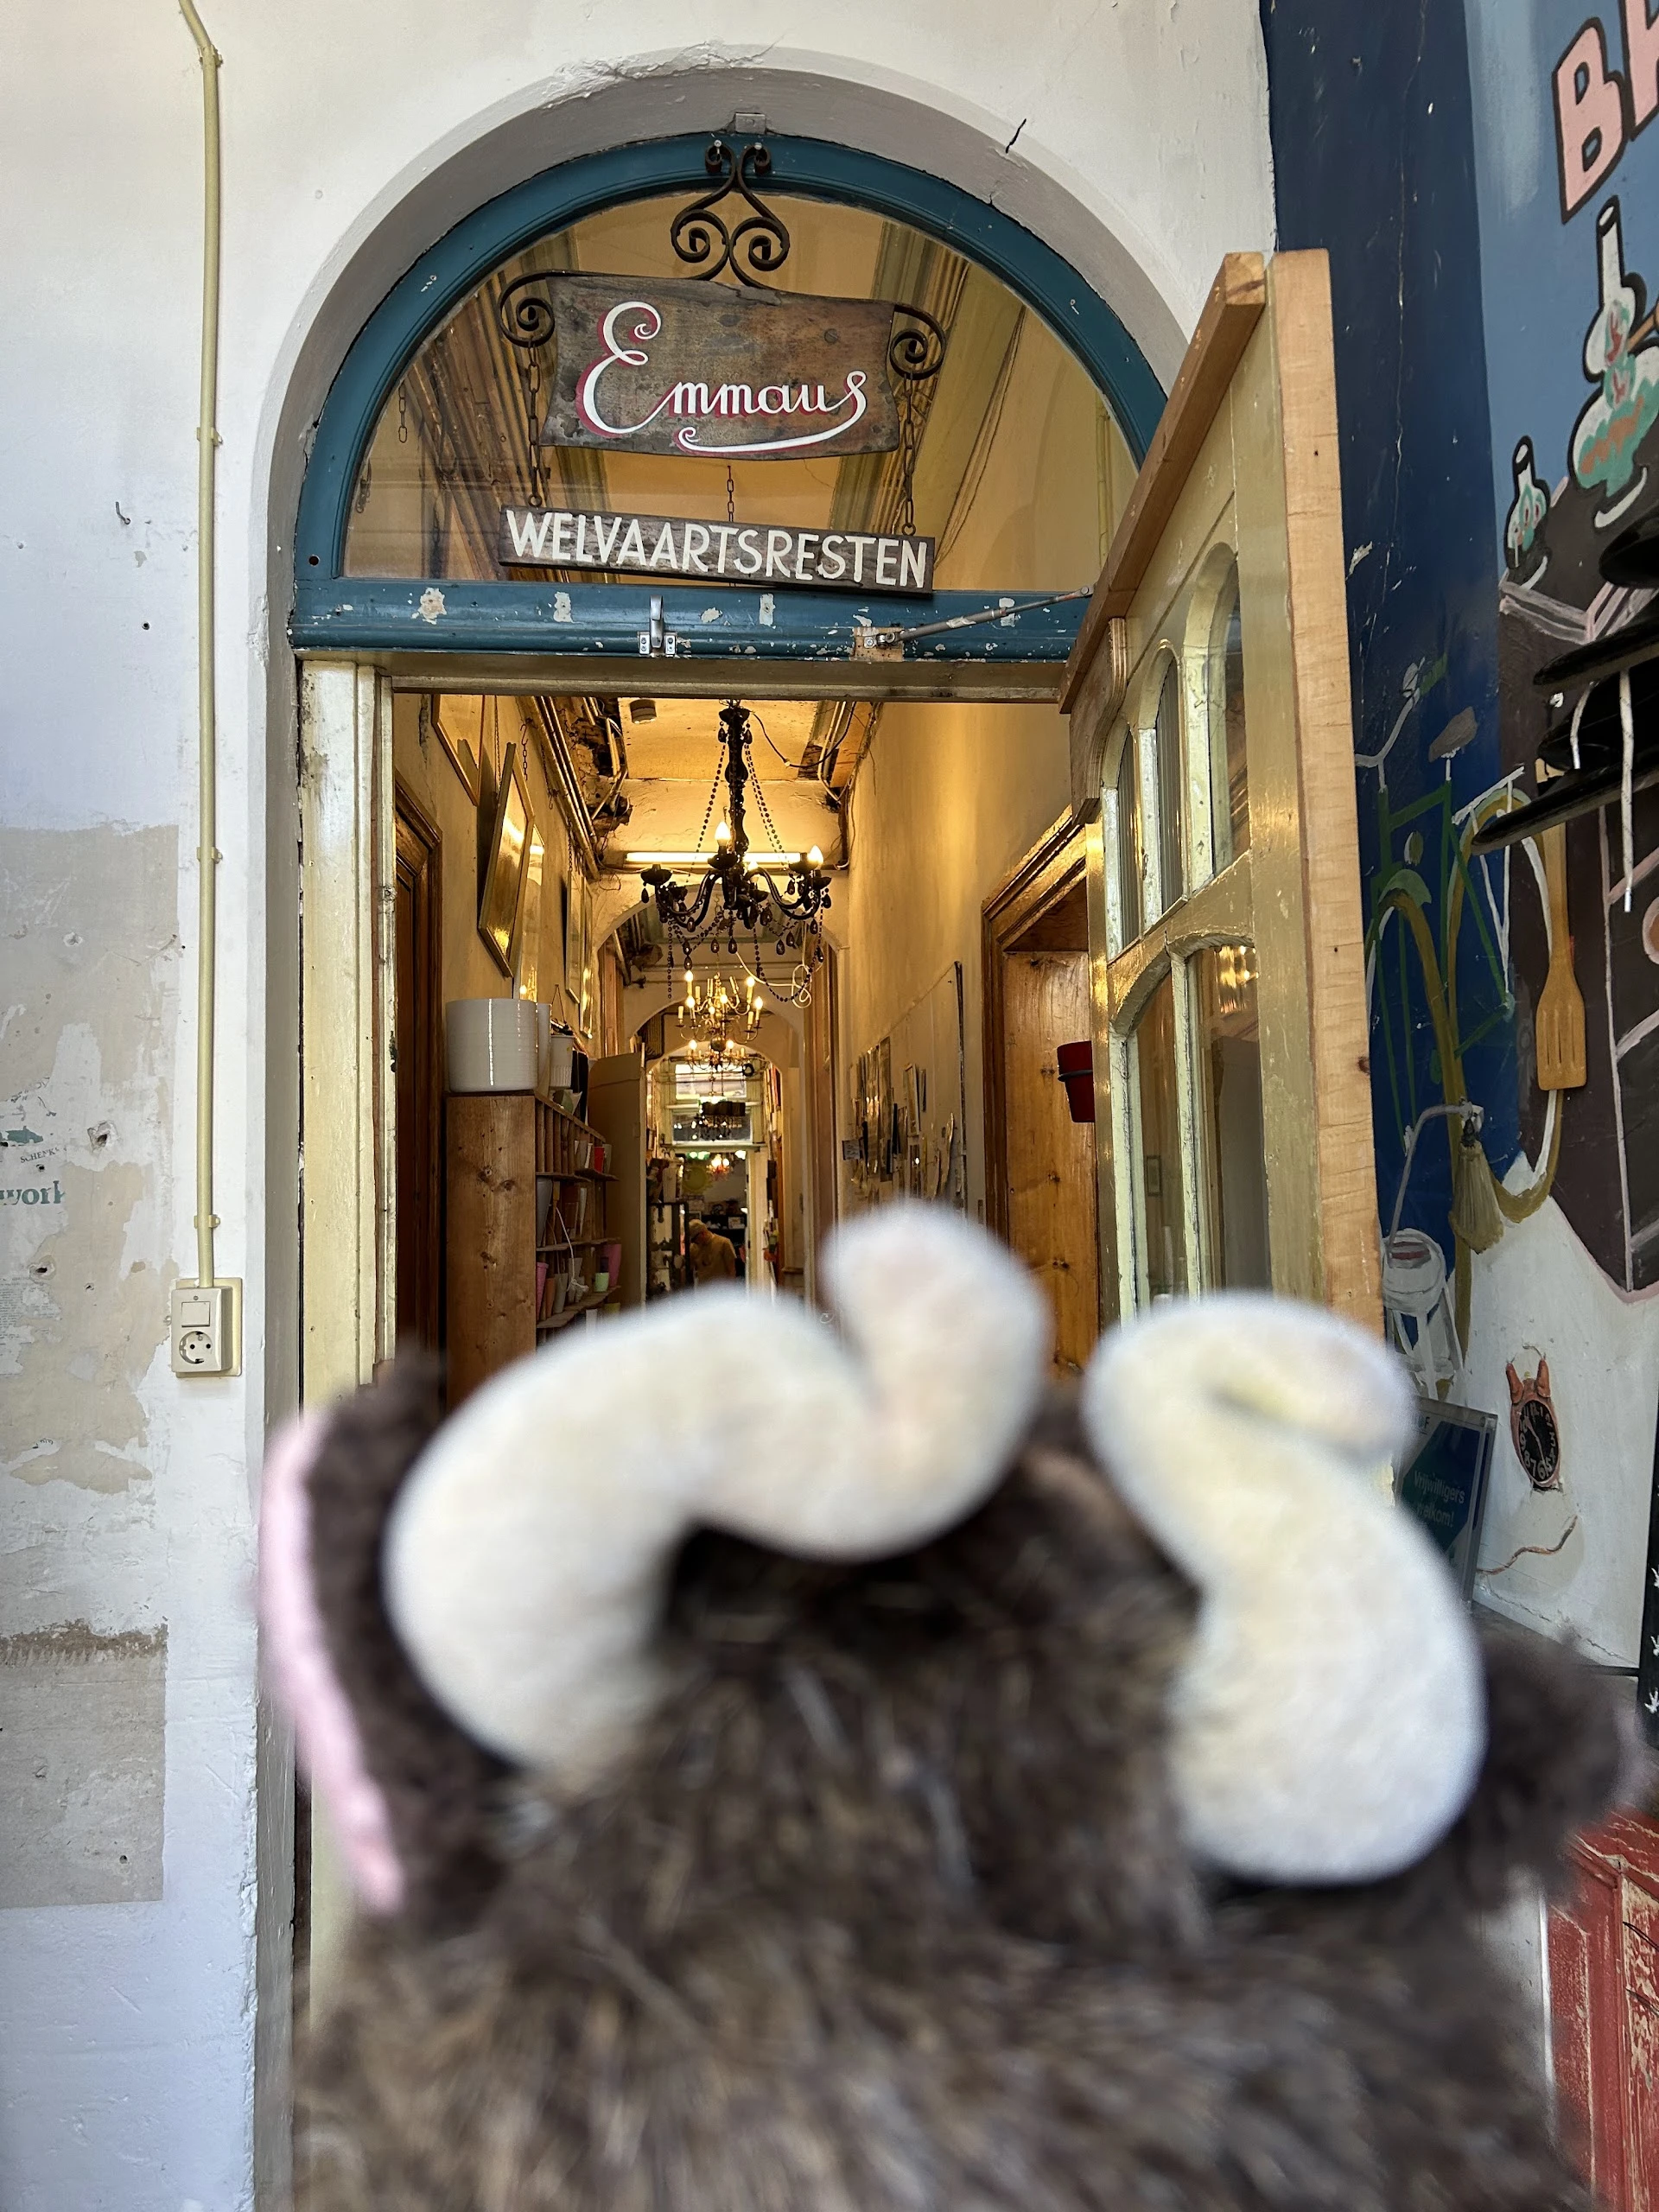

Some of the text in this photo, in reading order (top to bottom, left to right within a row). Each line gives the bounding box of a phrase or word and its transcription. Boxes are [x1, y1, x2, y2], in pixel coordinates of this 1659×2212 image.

[576, 301, 867, 453] Emmaus
[505, 509, 929, 589] WELVAARTSRESTEN
[1414, 1470, 1465, 1504] Vrijwilligers
